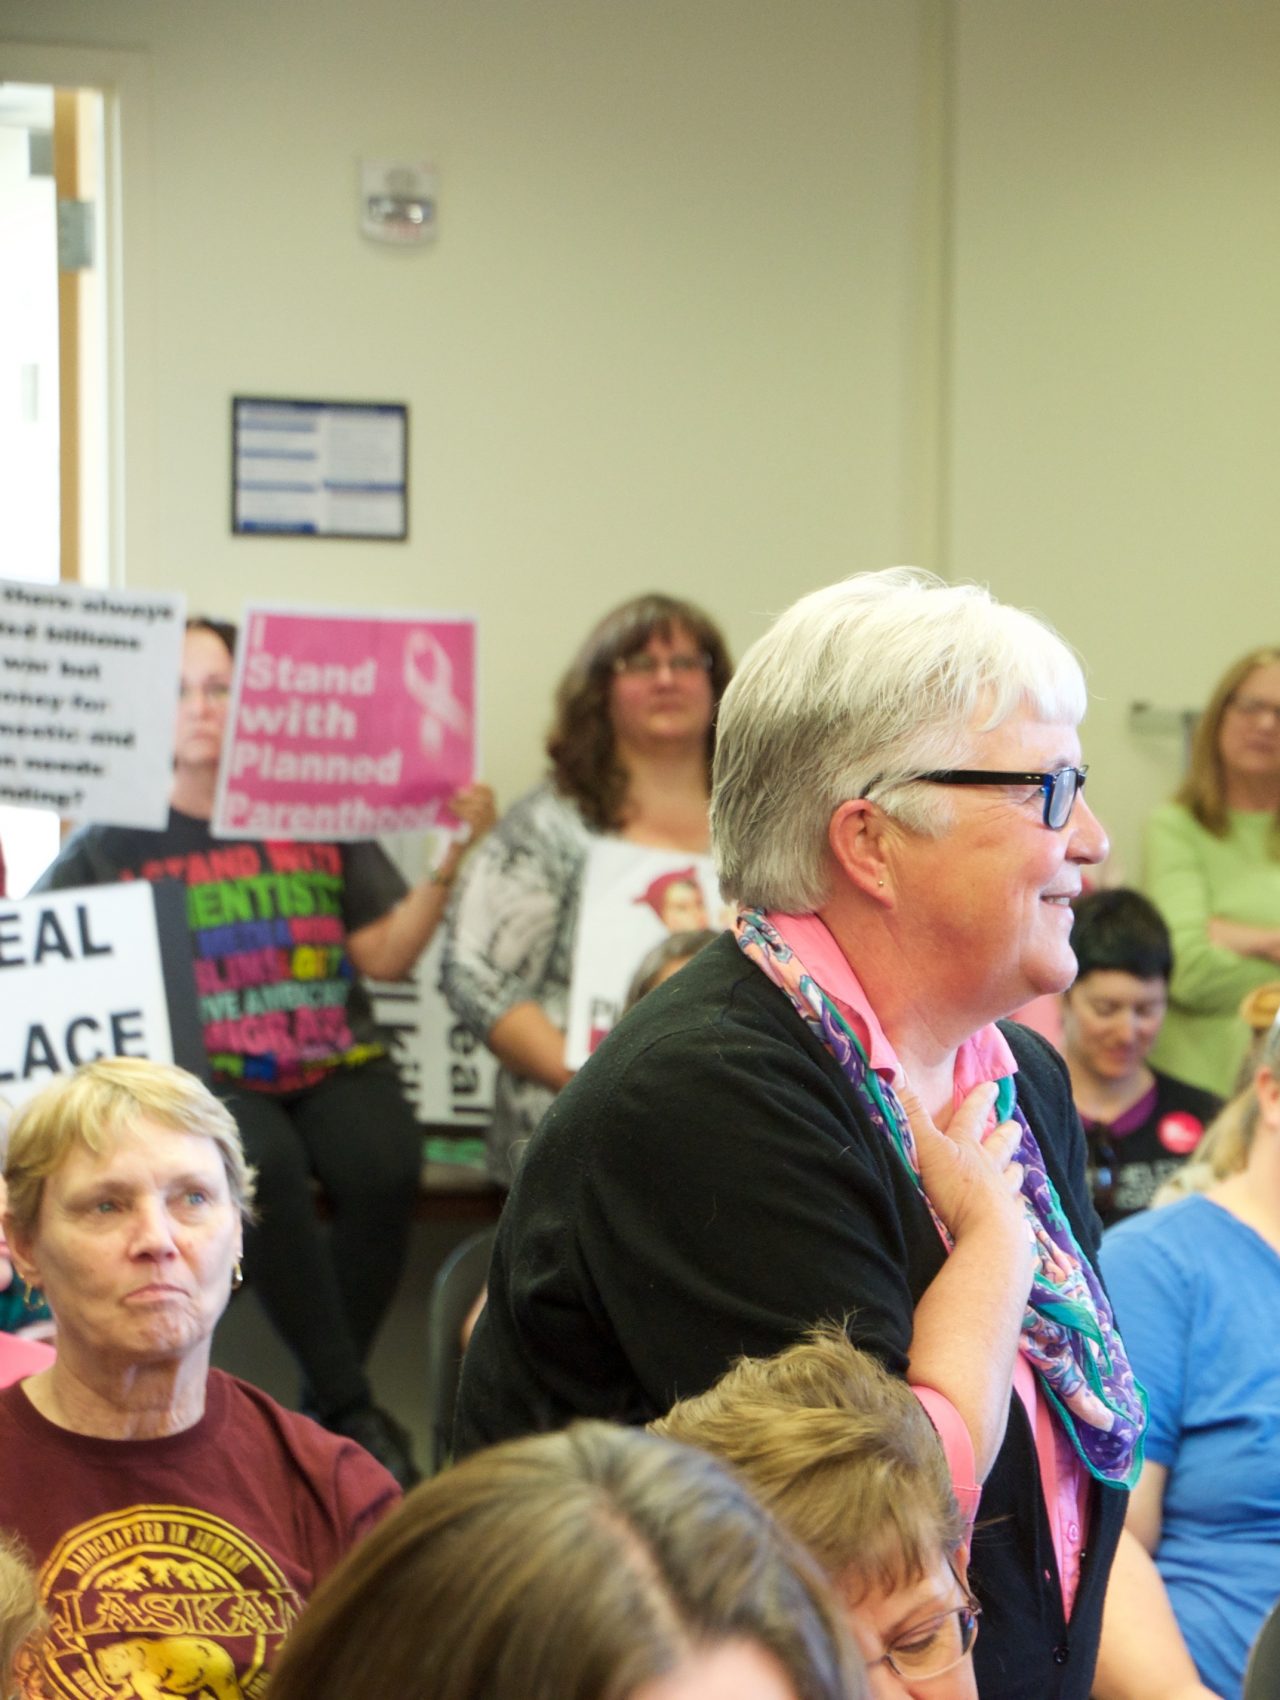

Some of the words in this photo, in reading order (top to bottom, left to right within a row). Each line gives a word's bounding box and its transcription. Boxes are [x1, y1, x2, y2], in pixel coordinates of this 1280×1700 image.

[248, 652, 377, 696] Stand
[239, 699, 357, 739] with
[230, 742, 403, 786] Planned
[63, 1521, 165, 1576] HANDCRAFTED
[168, 1522, 190, 1546] IN
